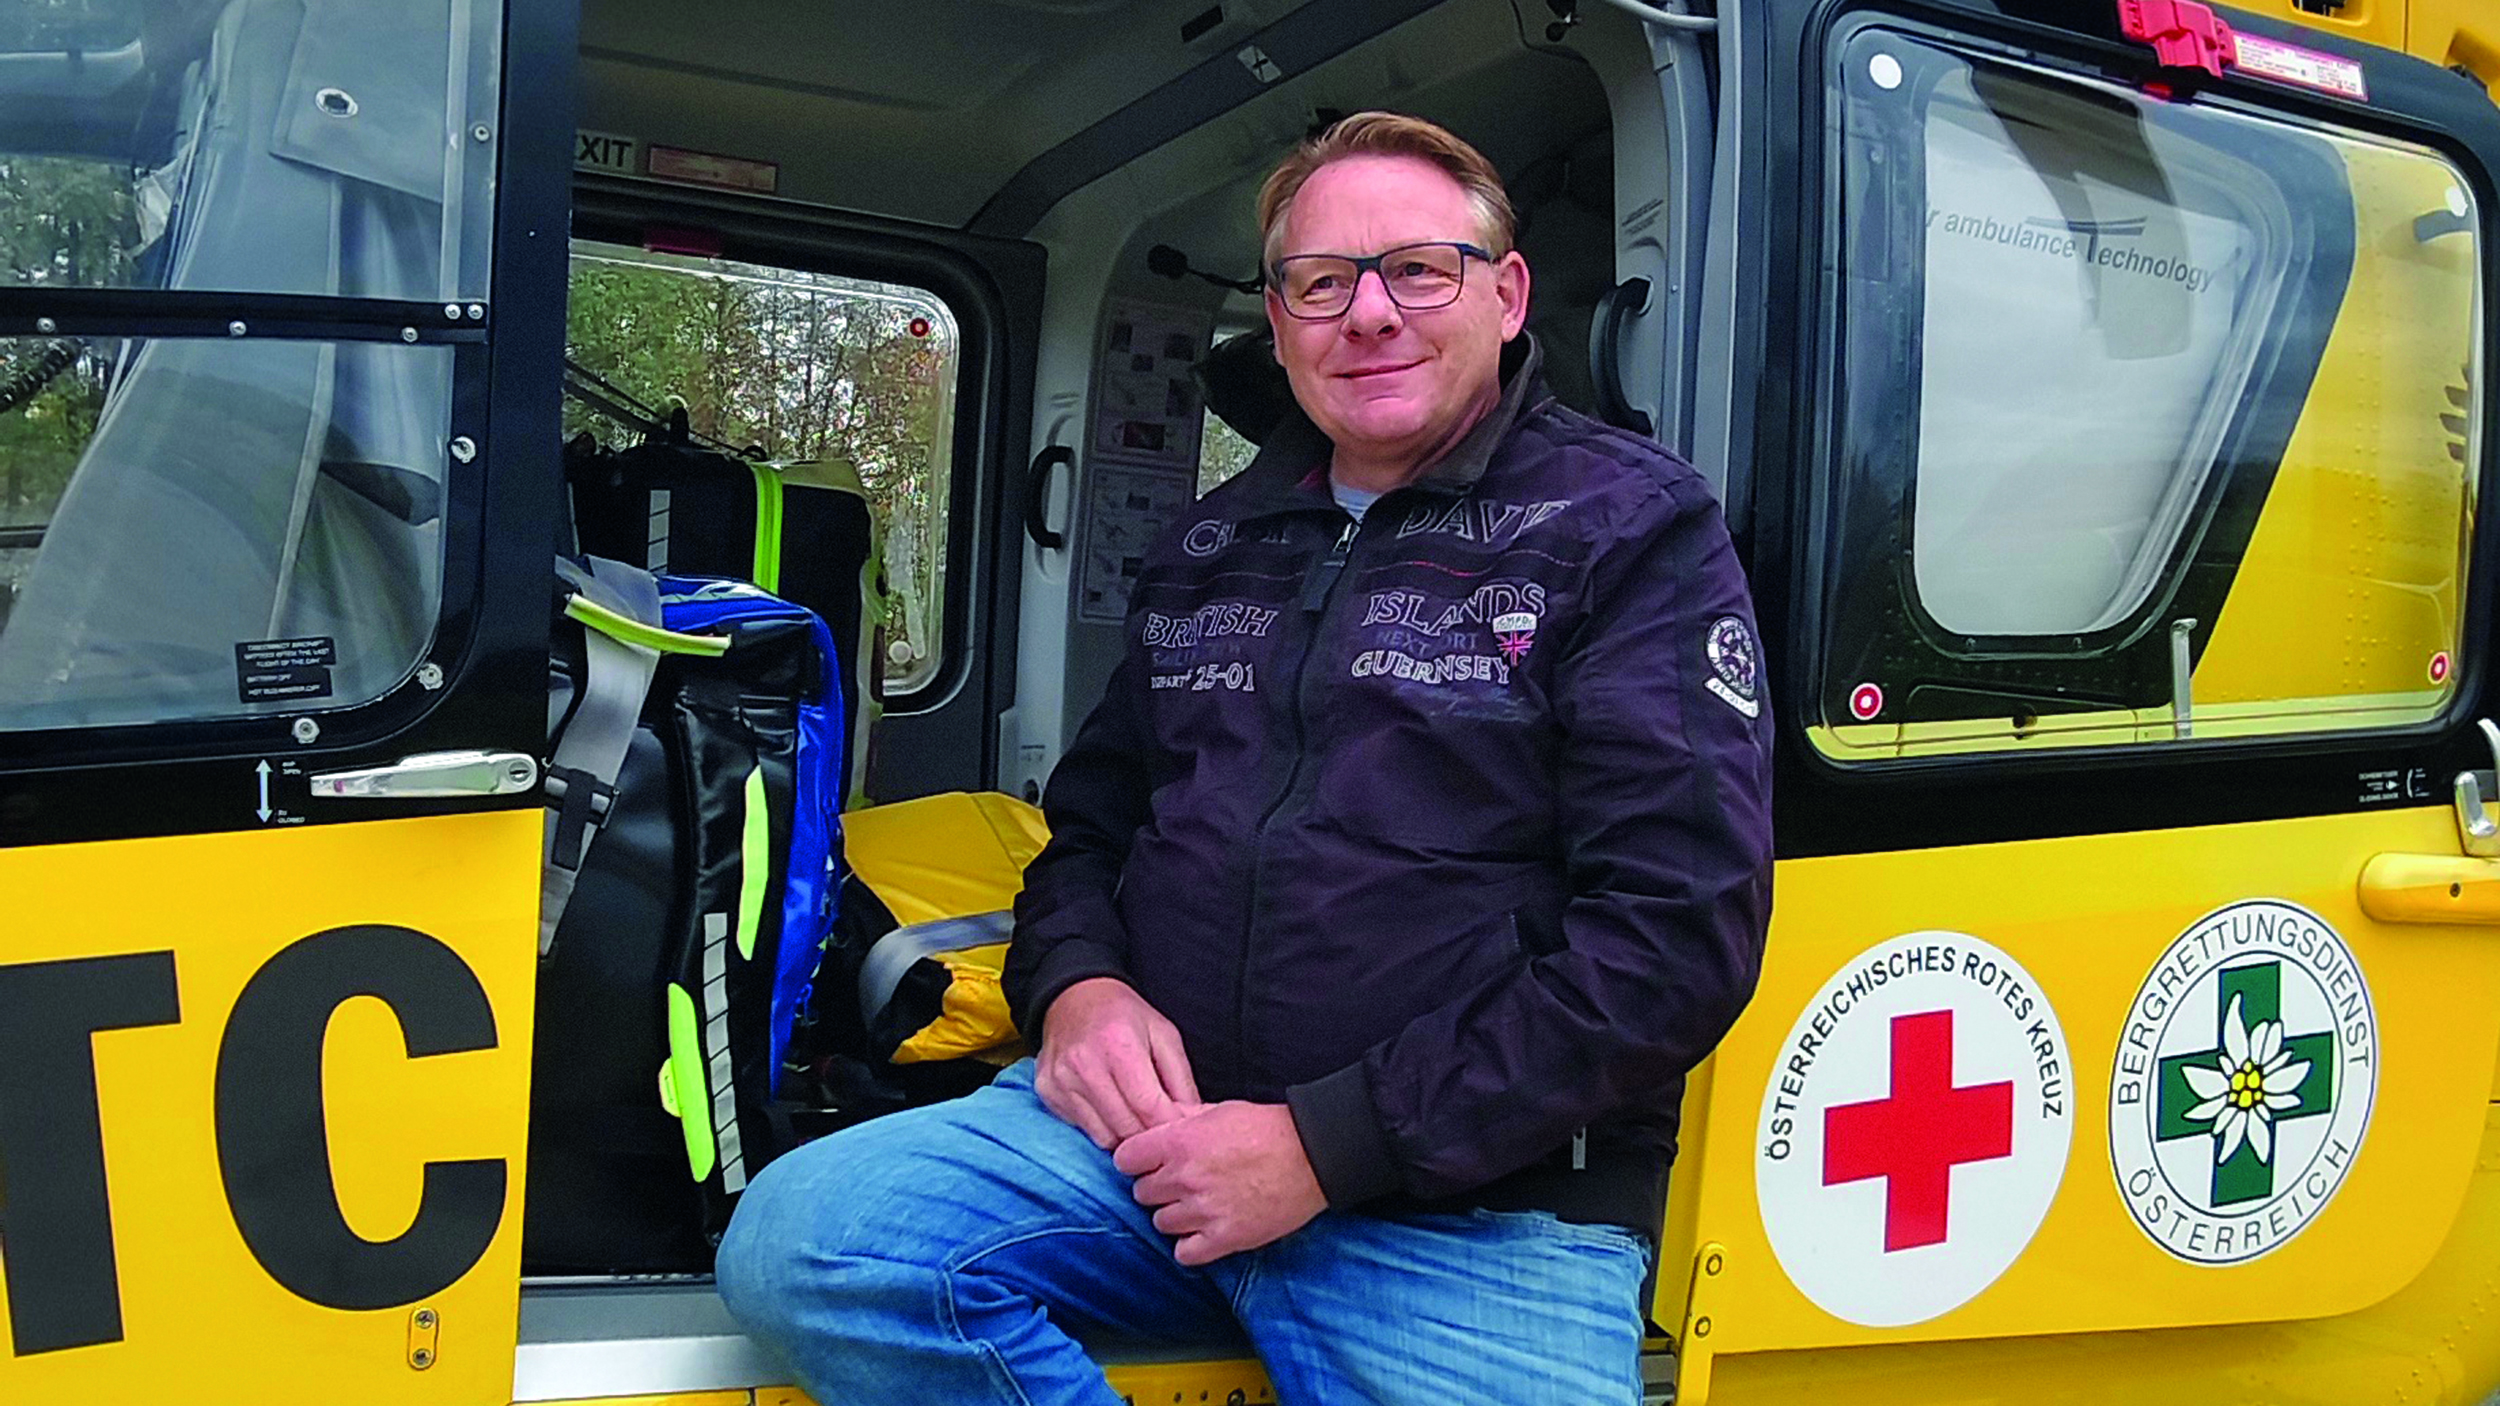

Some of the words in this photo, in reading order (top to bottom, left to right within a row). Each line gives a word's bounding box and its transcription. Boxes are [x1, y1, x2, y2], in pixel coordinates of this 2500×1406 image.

[573, 135, 632, 167] XIT
[1926, 203, 1940, 228] r
[1944, 212, 2076, 258] ambulance
[2066, 216, 2213, 291] Technology
[1361, 582, 1546, 636] ISLANDS
[1438, 631, 1479, 650] ORT
[1191, 662, 1255, 692] 25-01
[1351, 650, 1510, 684] GUERNSEY
[2118, 913, 2369, 1105] BERGRETTUNGSDIENST
[1764, 946, 1957, 1161] ÖSTERREICHISCHES
[1962, 952, 2034, 1021] ROTES
[2026, 1019, 2062, 1119] KREUZ
[0, 923, 508, 1358] TC
[2128, 1138, 2350, 1255] ÖSTERREICH
